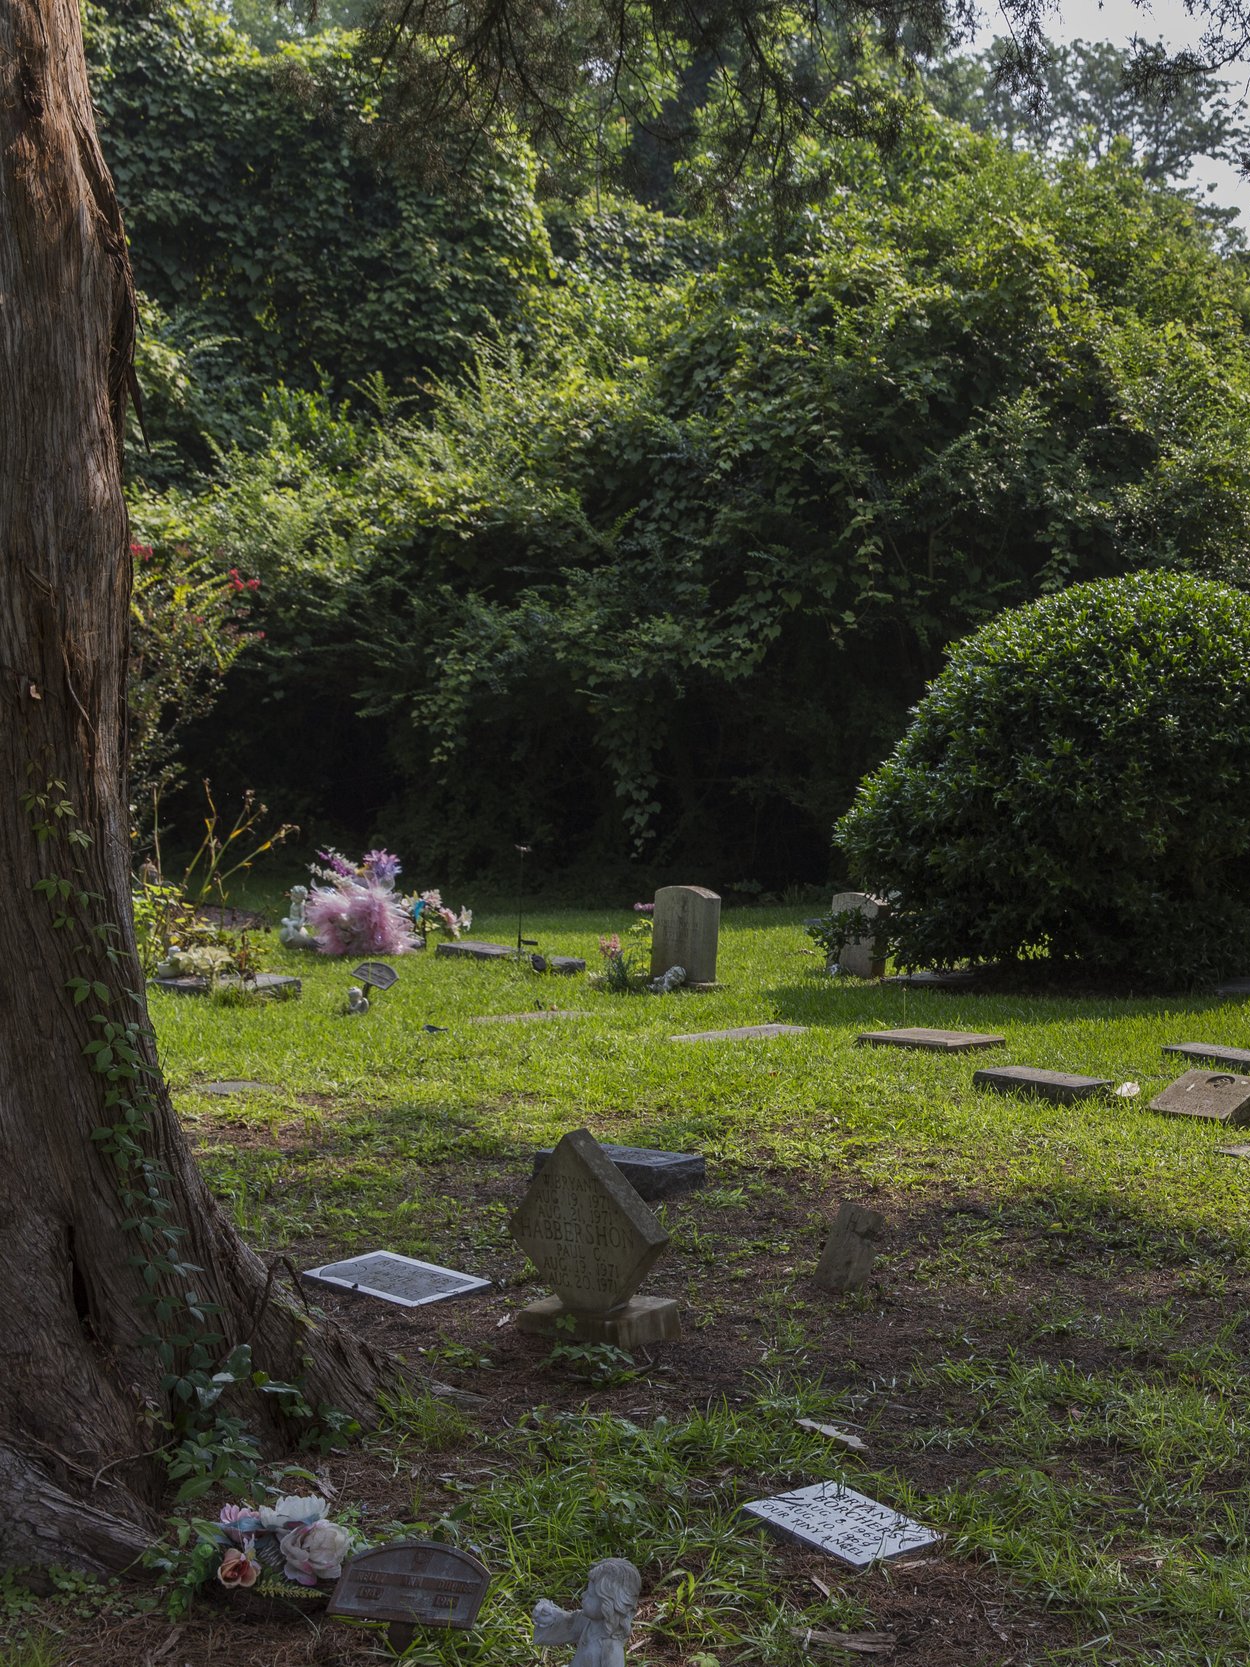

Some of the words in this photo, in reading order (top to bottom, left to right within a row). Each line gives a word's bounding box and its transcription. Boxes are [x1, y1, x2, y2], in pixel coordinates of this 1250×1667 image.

[588, 1195, 611, 1210] 1971
[589, 1210, 613, 1226] 1971
[520, 1216, 635, 1249] HABBERSHON
[557, 1244, 586, 1260] PAUL
[596, 1263, 619, 1279] 1971
[597, 1278, 619, 1293] 1971
[812, 1495, 903, 1539] BORCHERS
[762, 1503, 790, 1519] OUR
[790, 1518, 825, 1535] TINY
[821, 1535, 865, 1557] ANGEL
[849, 1525, 883, 1542] 1969
[837, 1531, 875, 1548] 1969
